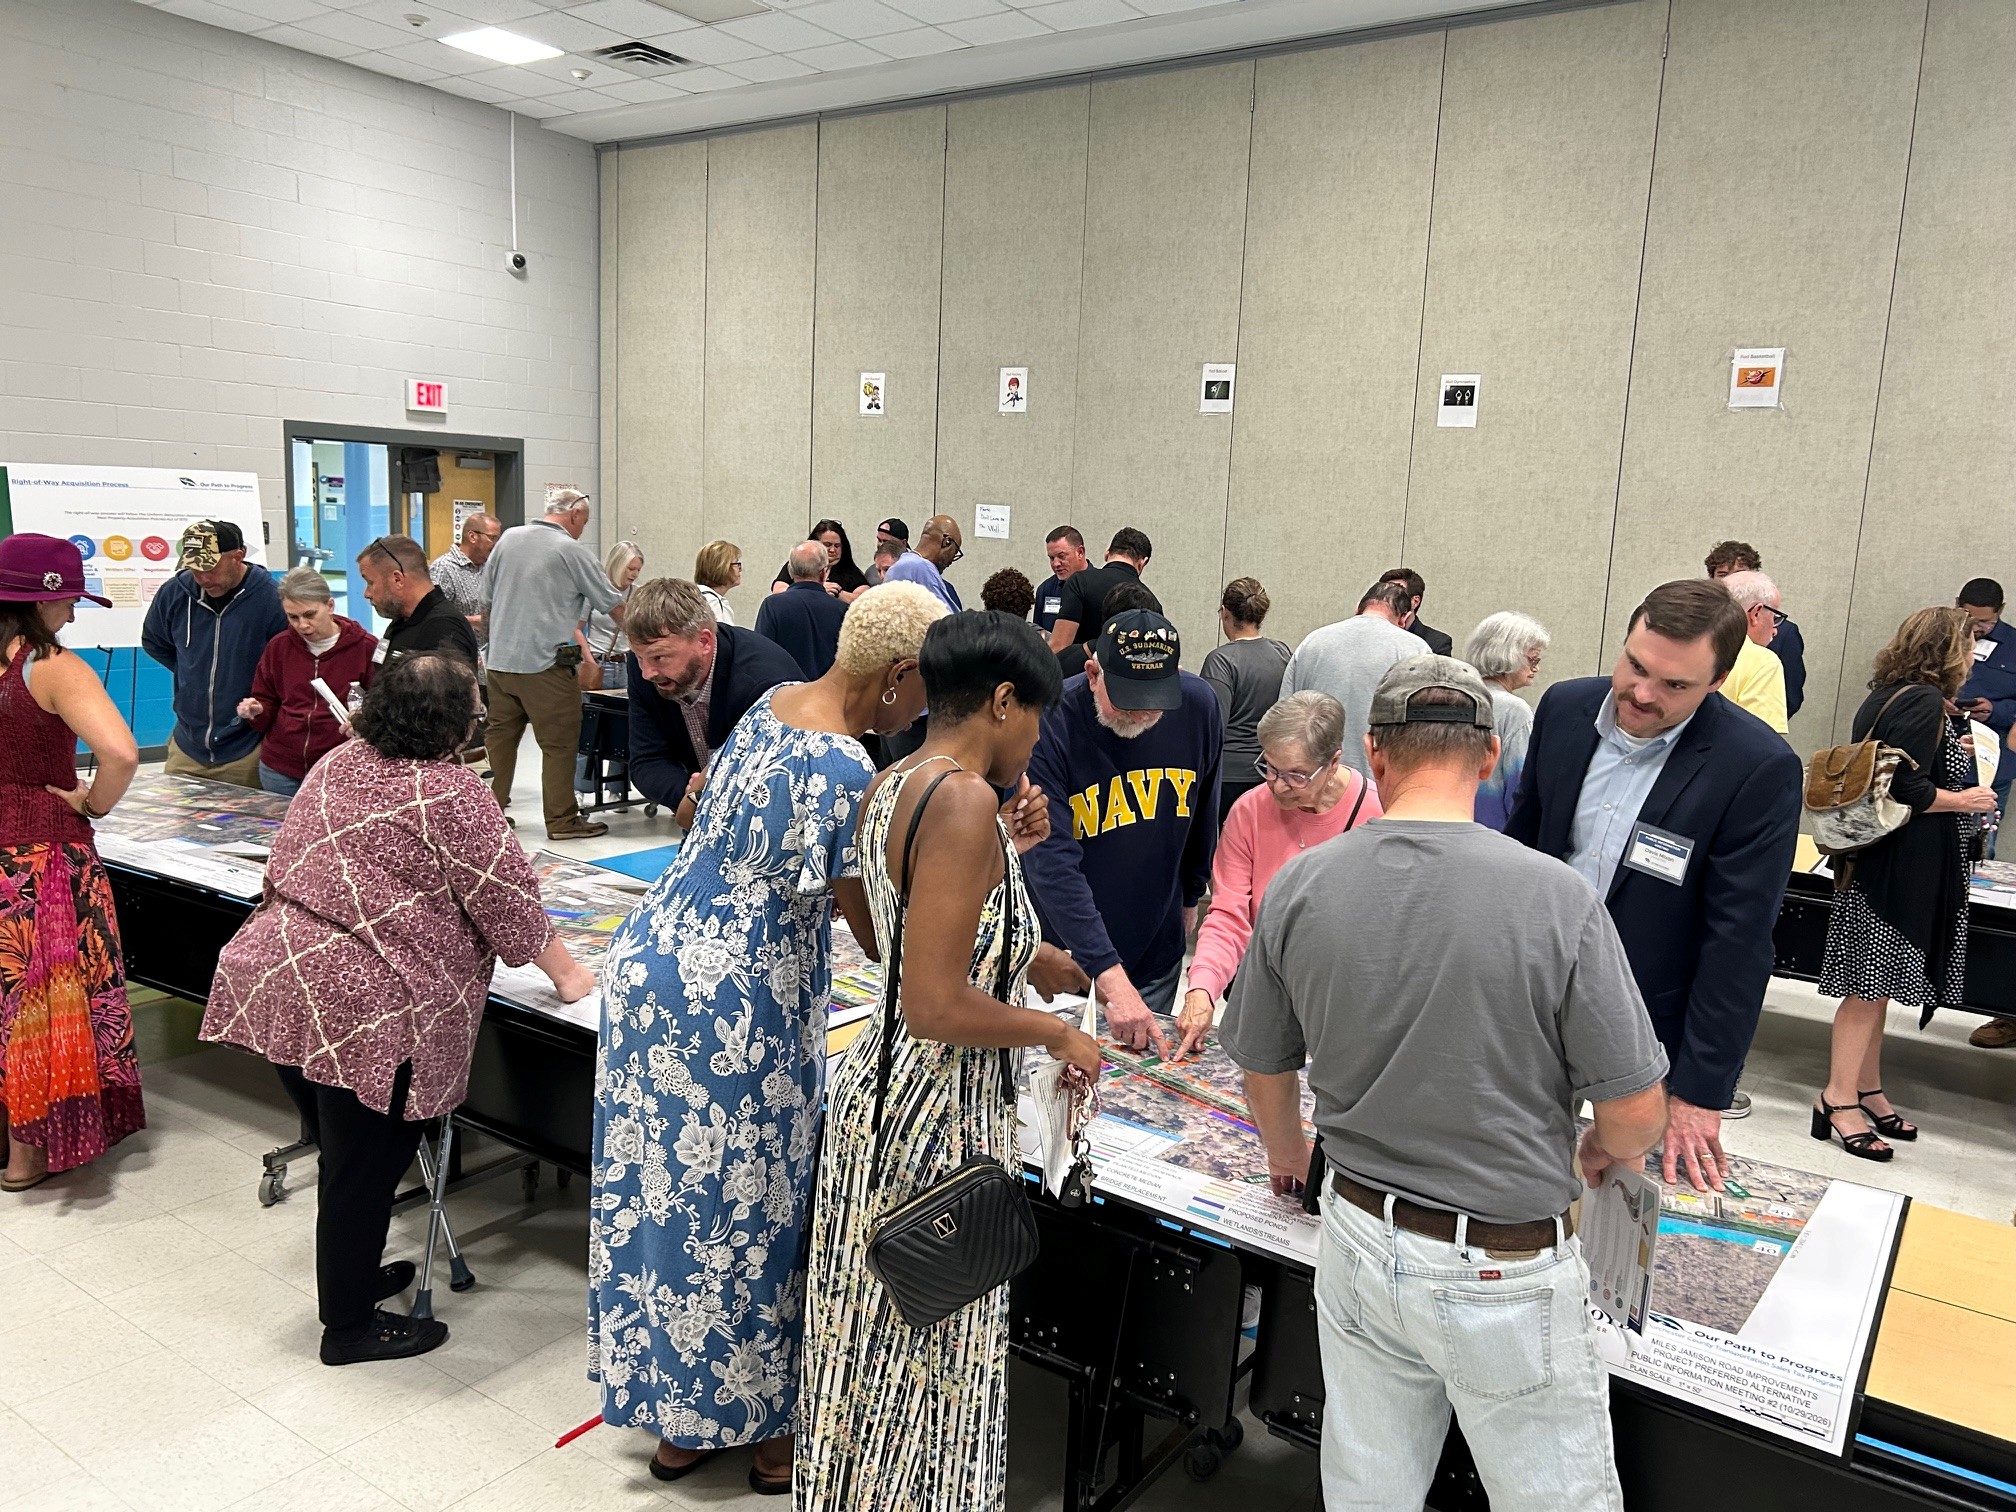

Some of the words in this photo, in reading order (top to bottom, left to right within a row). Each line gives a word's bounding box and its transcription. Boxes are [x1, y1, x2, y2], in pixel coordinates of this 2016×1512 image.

[416, 382, 443, 407] EXIT
[11, 478, 60, 488] Right-of-Way
[61, 480, 101, 488] Acquisition
[102, 481, 129, 489] Process
[1132, 641, 1175, 655] SUBMARINE
[1131, 662, 1164, 670] VETERAN
[1069, 768, 1196, 839] NAVY
[1100, 1175, 1122, 1187] BRIDGE
[1123, 1182, 1167, 1202] REPLACEMENT
[1106, 1167, 1138, 1181] CONCRETE
[1139, 1177, 1162, 1189] MEDIAN
[1223, 1217, 1291, 1247] WETLANDS/STREAMS
[1228, 1207, 1263, 1224] PROPOSED
[1265, 1218, 1288, 1232] PONDS
[1651, 1337, 1677, 1352] MILES
[1678, 1347, 1717, 1366] JAMISON
[1719, 1360, 1744, 1375] ROAD
[1745, 1369, 1819, 1401] IMPROVEMENTS
[1687, 1336, 1713, 1349] County
[1715, 1344, 1770, 1367] Transportation
[1771, 1363, 1791, 1374] Sales
[1793, 1368, 1806, 1378] Tax
[1807, 1373, 1842, 1389] Program
[1694, 1330, 1721, 1342] Our
[1724, 1339, 1756, 1355] Path
[1760, 1350, 1776, 1360] to
[1780, 1356, 1843, 1382] Progress
[1629, 1363, 1649, 1375] PLAN
[1650, 1370, 1672, 1384] SCALE
[1630, 1350, 1662, 1367] PUBLIC
[1663, 1361, 1724, 1390] INFORMATION
[1724, 1383, 1766, 1404] MEETING
[1766, 1398, 1778, 1408] #2
[1653, 1348, 1694, 1367] PROJECT
[1694, 1362, 1749, 1387] PREFERRED
[1750, 1381, 1812, 1409] ALTERNATIVE
